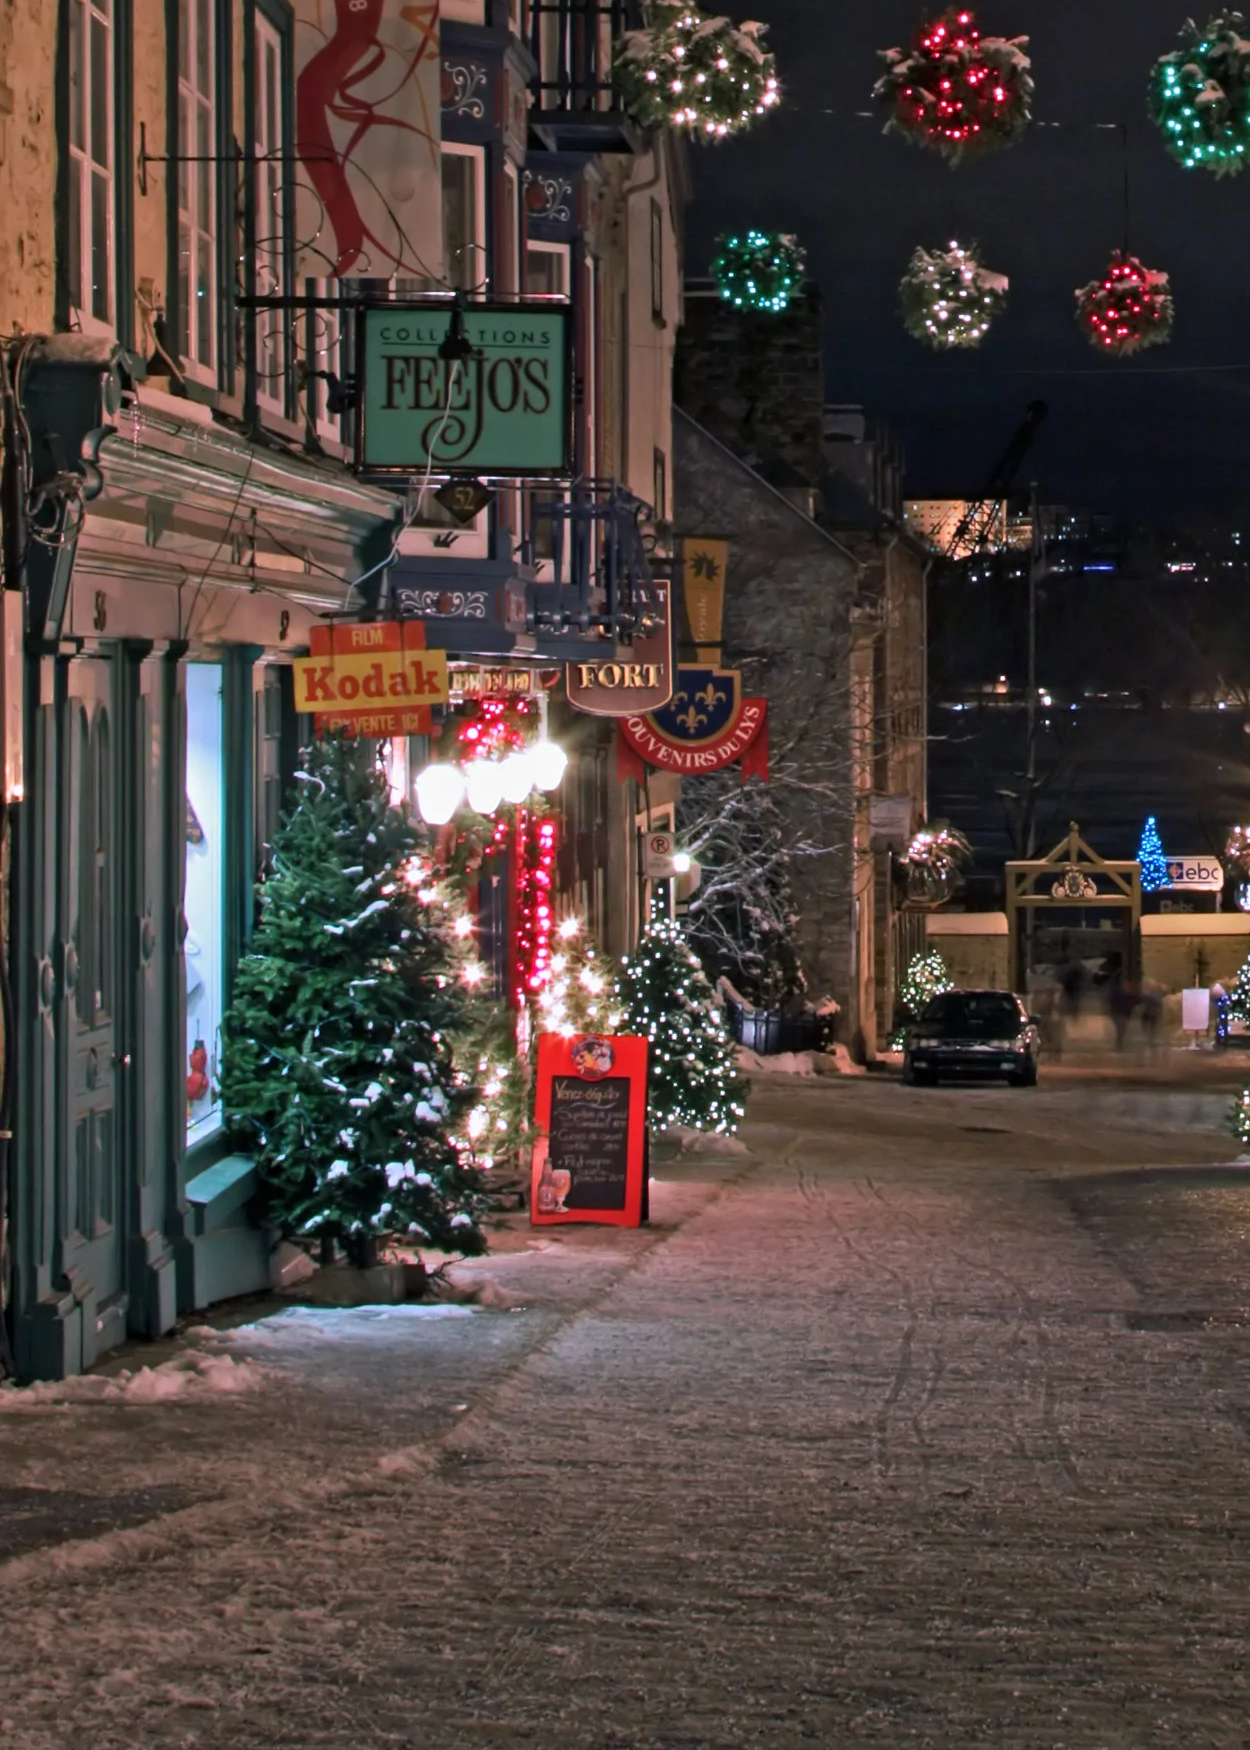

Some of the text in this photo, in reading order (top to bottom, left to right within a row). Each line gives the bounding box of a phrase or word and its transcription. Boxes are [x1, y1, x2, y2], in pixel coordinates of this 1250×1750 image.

[380, 327, 551, 344] COLLTIONS
[453, 486, 476, 510] 52
[352, 629, 384, 647] FILM
[302, 660, 441, 702] Kodak
[577, 663, 660, 688] FORT
[353, 714, 397, 734] VENTE
[402, 711, 419, 729] ICI
[625, 705, 761, 767] OUVENIRS DU LYS
[1185, 862, 1219, 881] ebc
